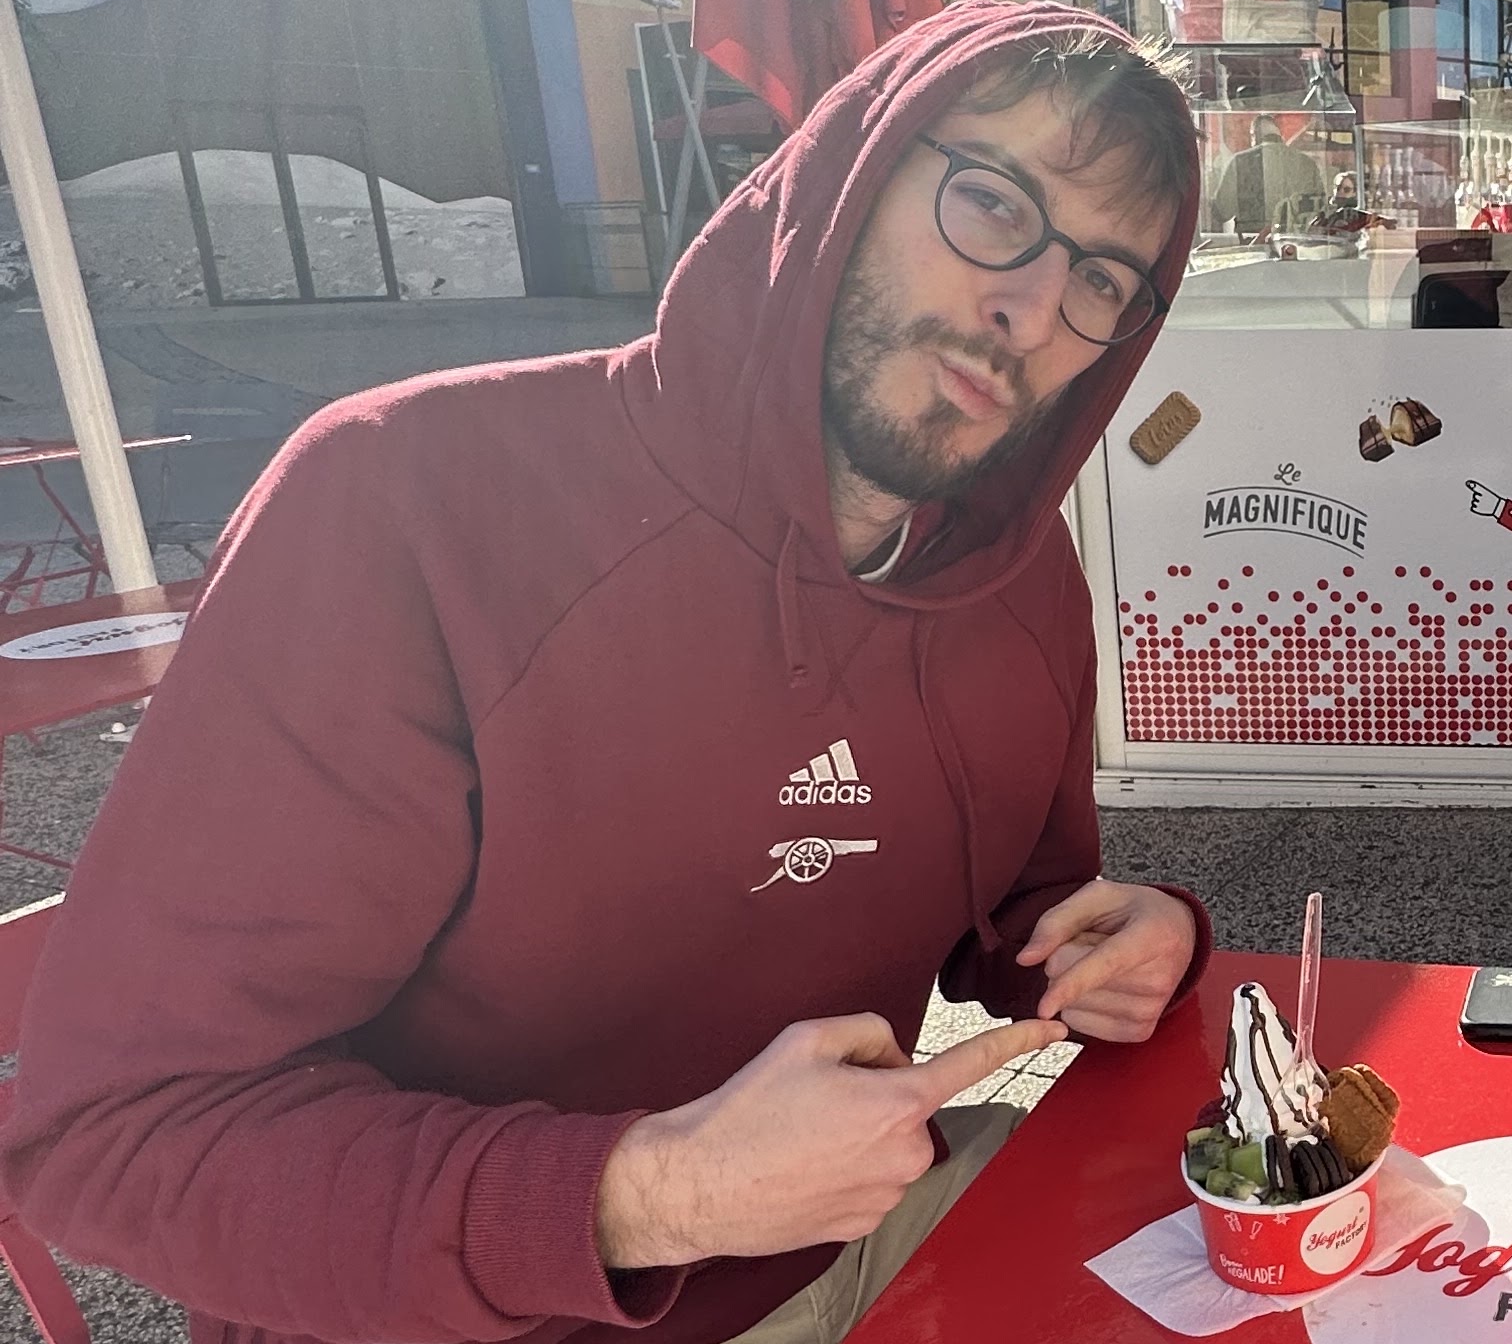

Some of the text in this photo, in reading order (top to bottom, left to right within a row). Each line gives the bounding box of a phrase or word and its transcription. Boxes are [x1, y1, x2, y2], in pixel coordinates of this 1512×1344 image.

[1273, 462, 1302, 486] Le
[1203, 493, 1368, 550] MAGNIFIQUE
[778, 779, 873, 806] adidas
[1307, 1216, 1358, 1252] Yogurt
